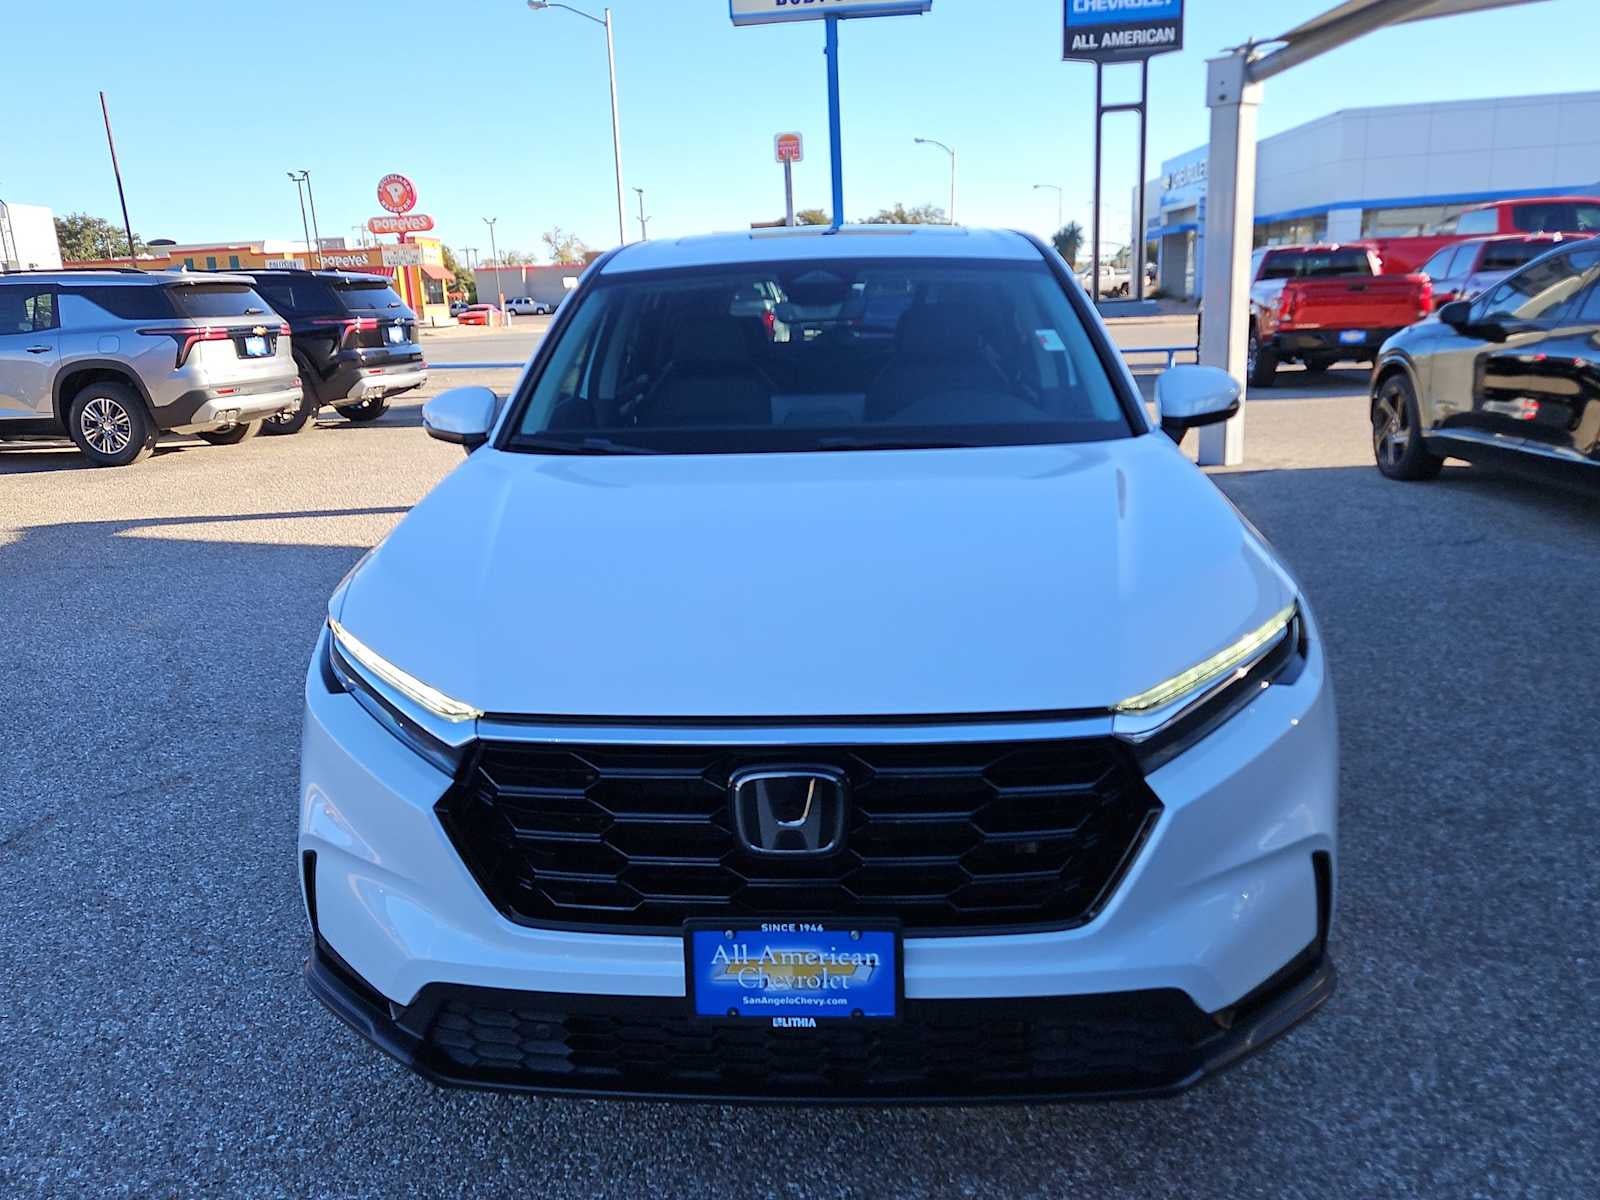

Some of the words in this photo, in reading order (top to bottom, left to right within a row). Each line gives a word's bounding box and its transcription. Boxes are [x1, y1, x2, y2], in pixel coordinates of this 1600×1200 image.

[1073, 0, 1173, 13] CHEVRO
[1072, 33, 1099, 50] ALL
[1101, 27, 1176, 48] AMERICAN
[761, 923, 796, 933] SINCE
[800, 923, 824, 933] 1946
[711, 944, 749, 965] All
[758, 944, 880, 966] American
[738, 967, 849, 990] Chevrolet
[743, 996, 848, 1006] SanAngeloChevy.com
